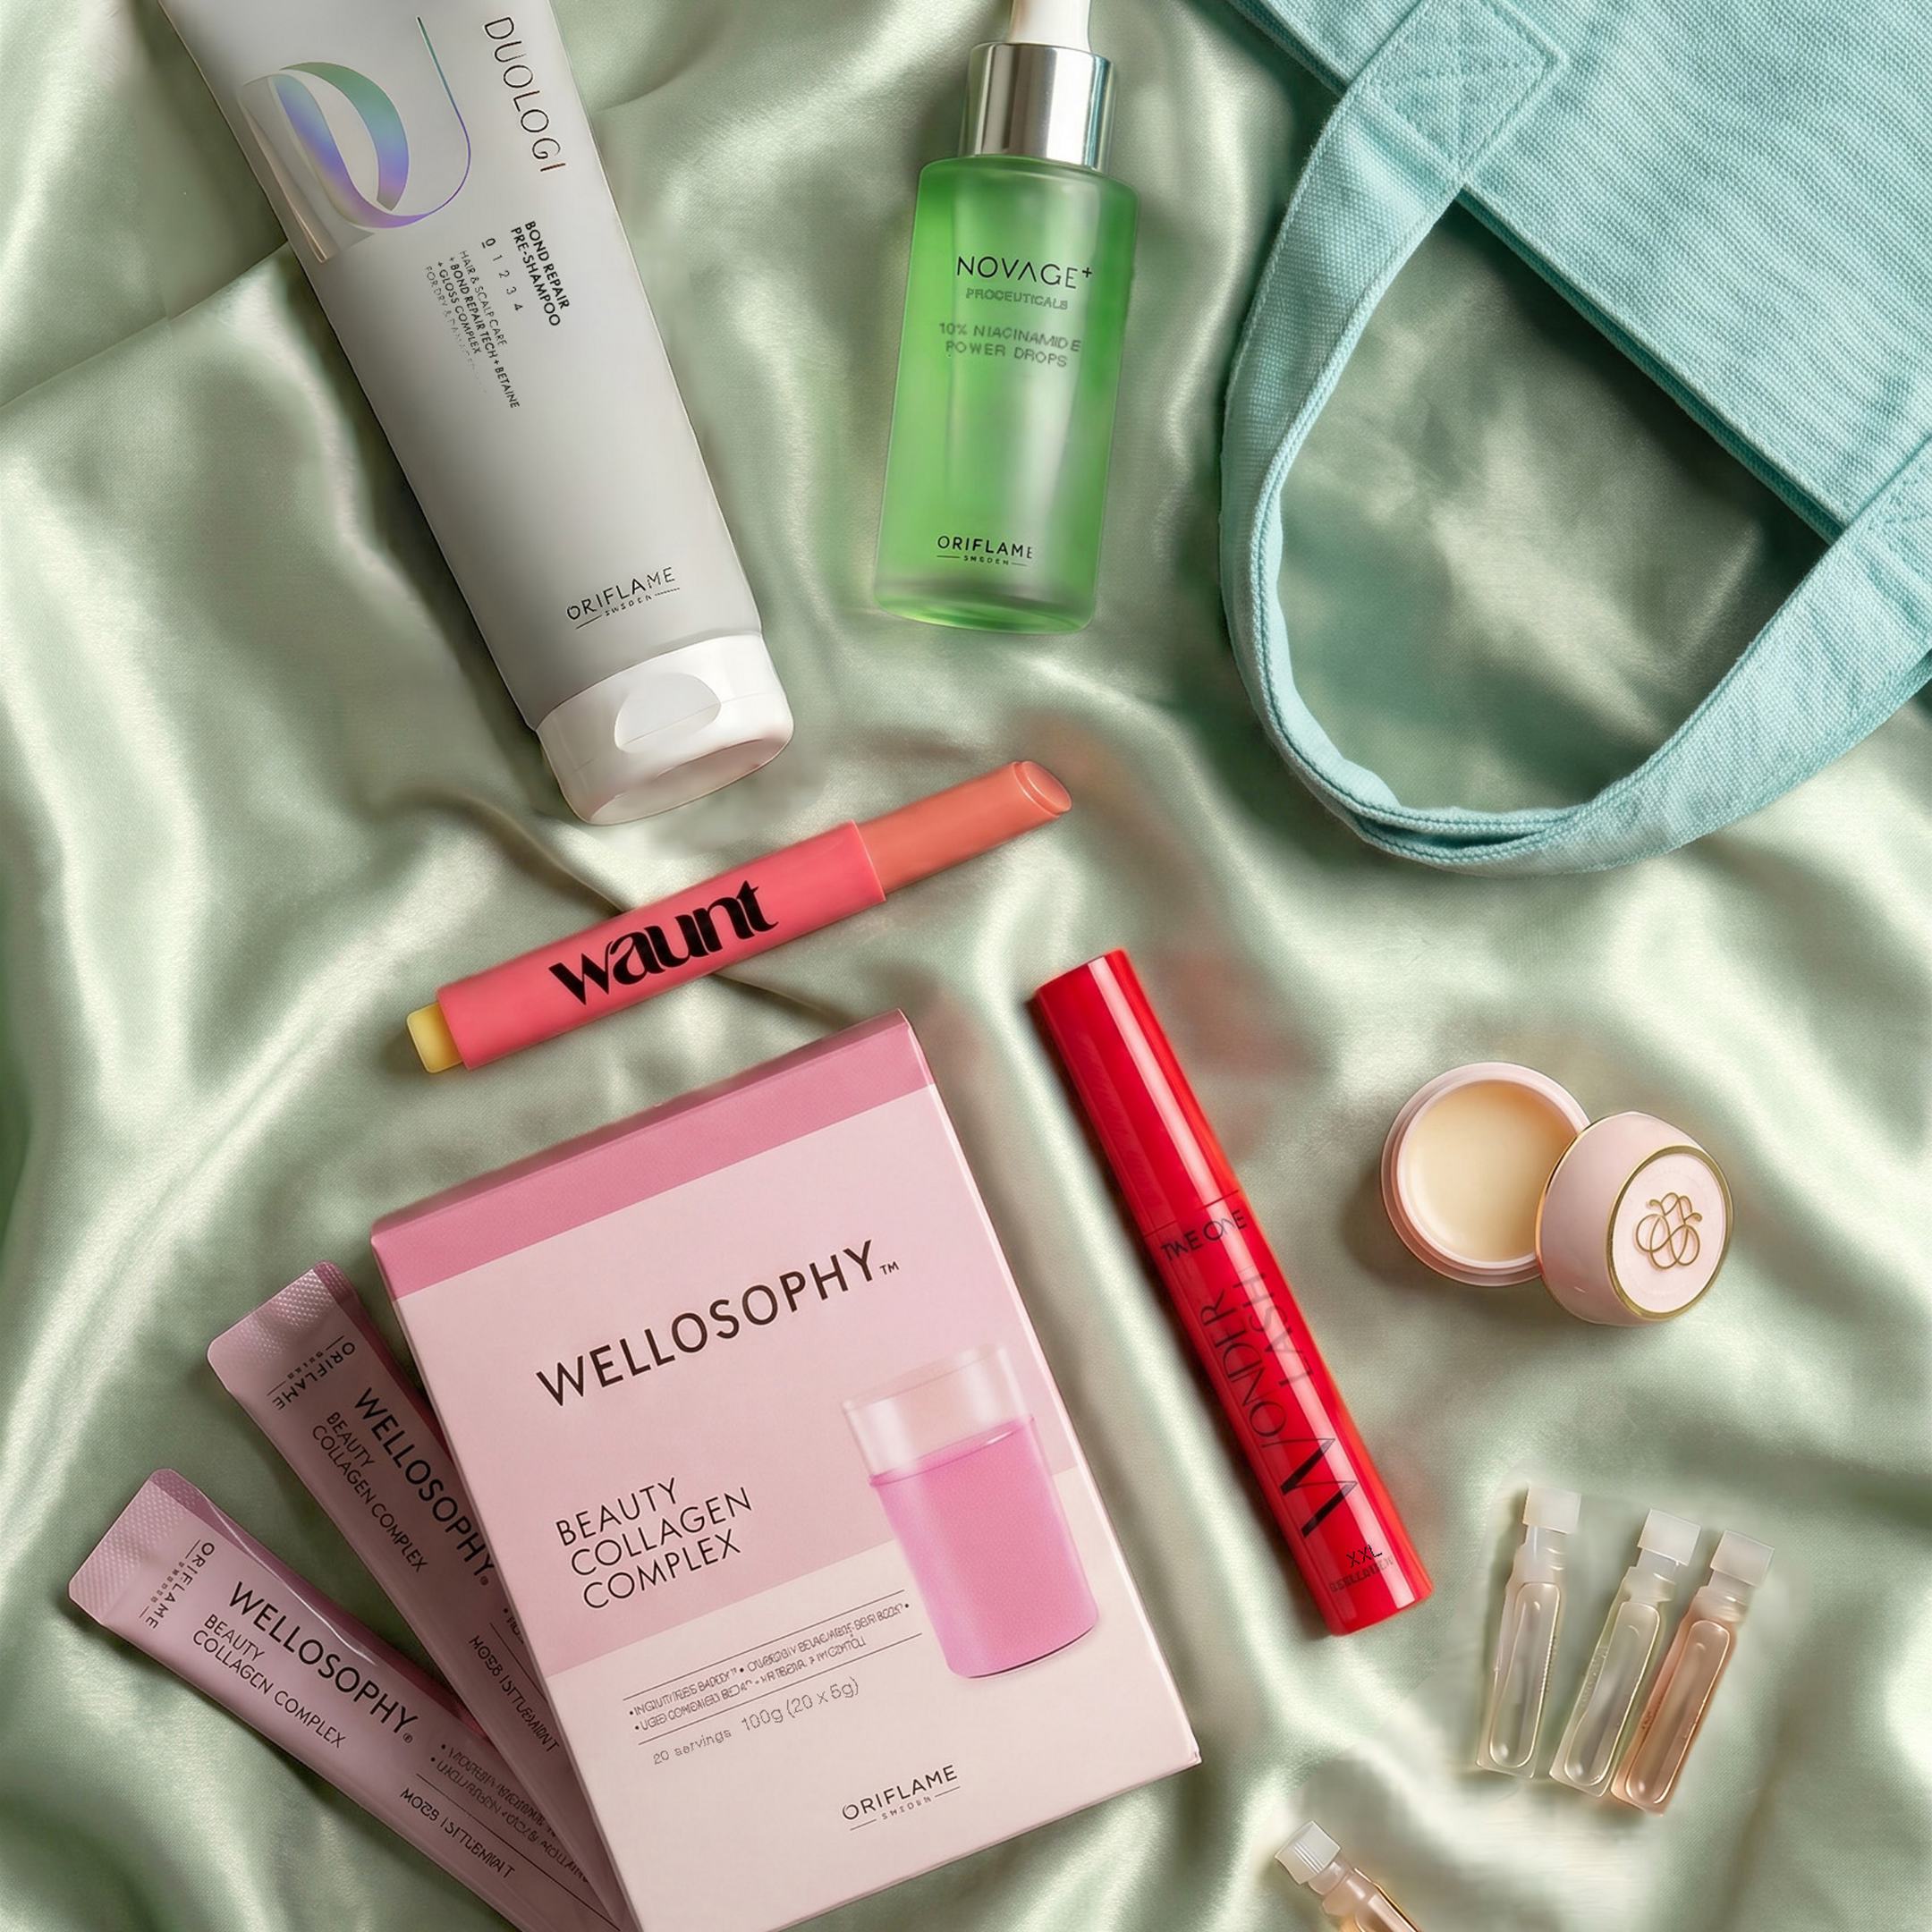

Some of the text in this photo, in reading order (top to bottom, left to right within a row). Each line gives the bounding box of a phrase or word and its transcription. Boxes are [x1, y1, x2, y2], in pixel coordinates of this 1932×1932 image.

[484, 16, 566, 172] DUOLOGI
[460, 250, 508, 347] HAIR & SCALP CARE
[492, 254, 503, 262] 1
[498, 269, 510, 278] 2
[506, 286, 517, 295] 3
[514, 303, 523, 311] 4
[511, 226, 561, 326] PRE-SHAMPOO
[525, 220, 570, 309] BOND REPAIR
[439, 269, 460, 304] GLOSS
[455, 305, 482, 354] COMPLEX
[450, 263, 470, 295] BOND
[464, 295, 486, 330] REPAIR
[480, 332, 498, 359] TECH
[495, 367, 521, 409] BETAINE
[939, 322, 968, 335] 10%
[945, 340, 1067, 368] POWER DROPS
[937, 535, 1032, 559] ORIFLAME
[566, 567, 675, 621] ORIFLAME
[547, 879, 780, 1005] waunt
[272, 1342, 355, 1411] ORIFLAME
[326, 1411, 376, 1469] BEAUTY
[312, 1424, 429, 1574] COLLAGEN COMPLEX
[555, 1477, 677, 1547] BEAUTY
[571, 1487, 752, 1576] COLLAGEN
[145, 1542, 215, 1629] ORIFLAME
[583, 1528, 741, 1609] COMPLEX
[1346, 1544, 1383, 1568] XXL
[203, 1614, 266, 1662] BEAUTY
[274, 1690, 347, 1750] COMPLEX
[653, 1750, 670, 1765] 20
[741, 1707, 784, 1732] 100g
[842, 1764, 957, 1820] ORIFLAME
